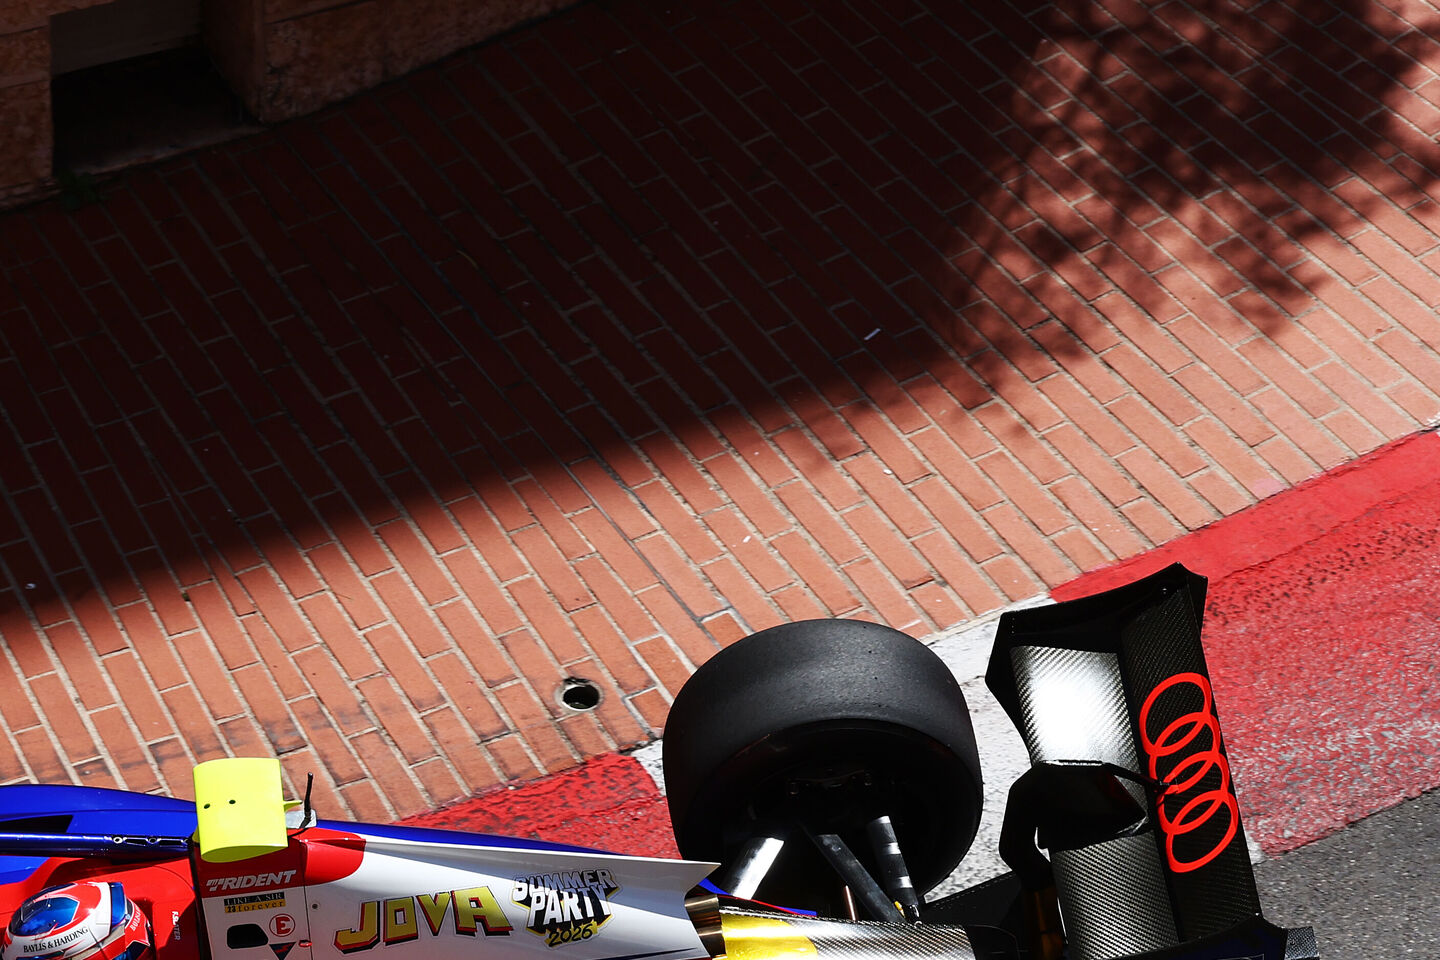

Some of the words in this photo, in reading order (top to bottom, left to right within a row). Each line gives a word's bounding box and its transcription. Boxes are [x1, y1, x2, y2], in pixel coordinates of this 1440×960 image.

[206, 870, 297, 892] TRIDENT
[514, 869, 618, 901] SUMMER
[527, 885, 612, 927] PARTY
[275, 916, 291, 935] E
[333, 885, 514, 955] JOVA
[23, 942, 47, 953] BAYLIS
[47, 940, 55, 949] &
[54, 926, 90, 947] HARDING
[547, 923, 595, 947] 2026
